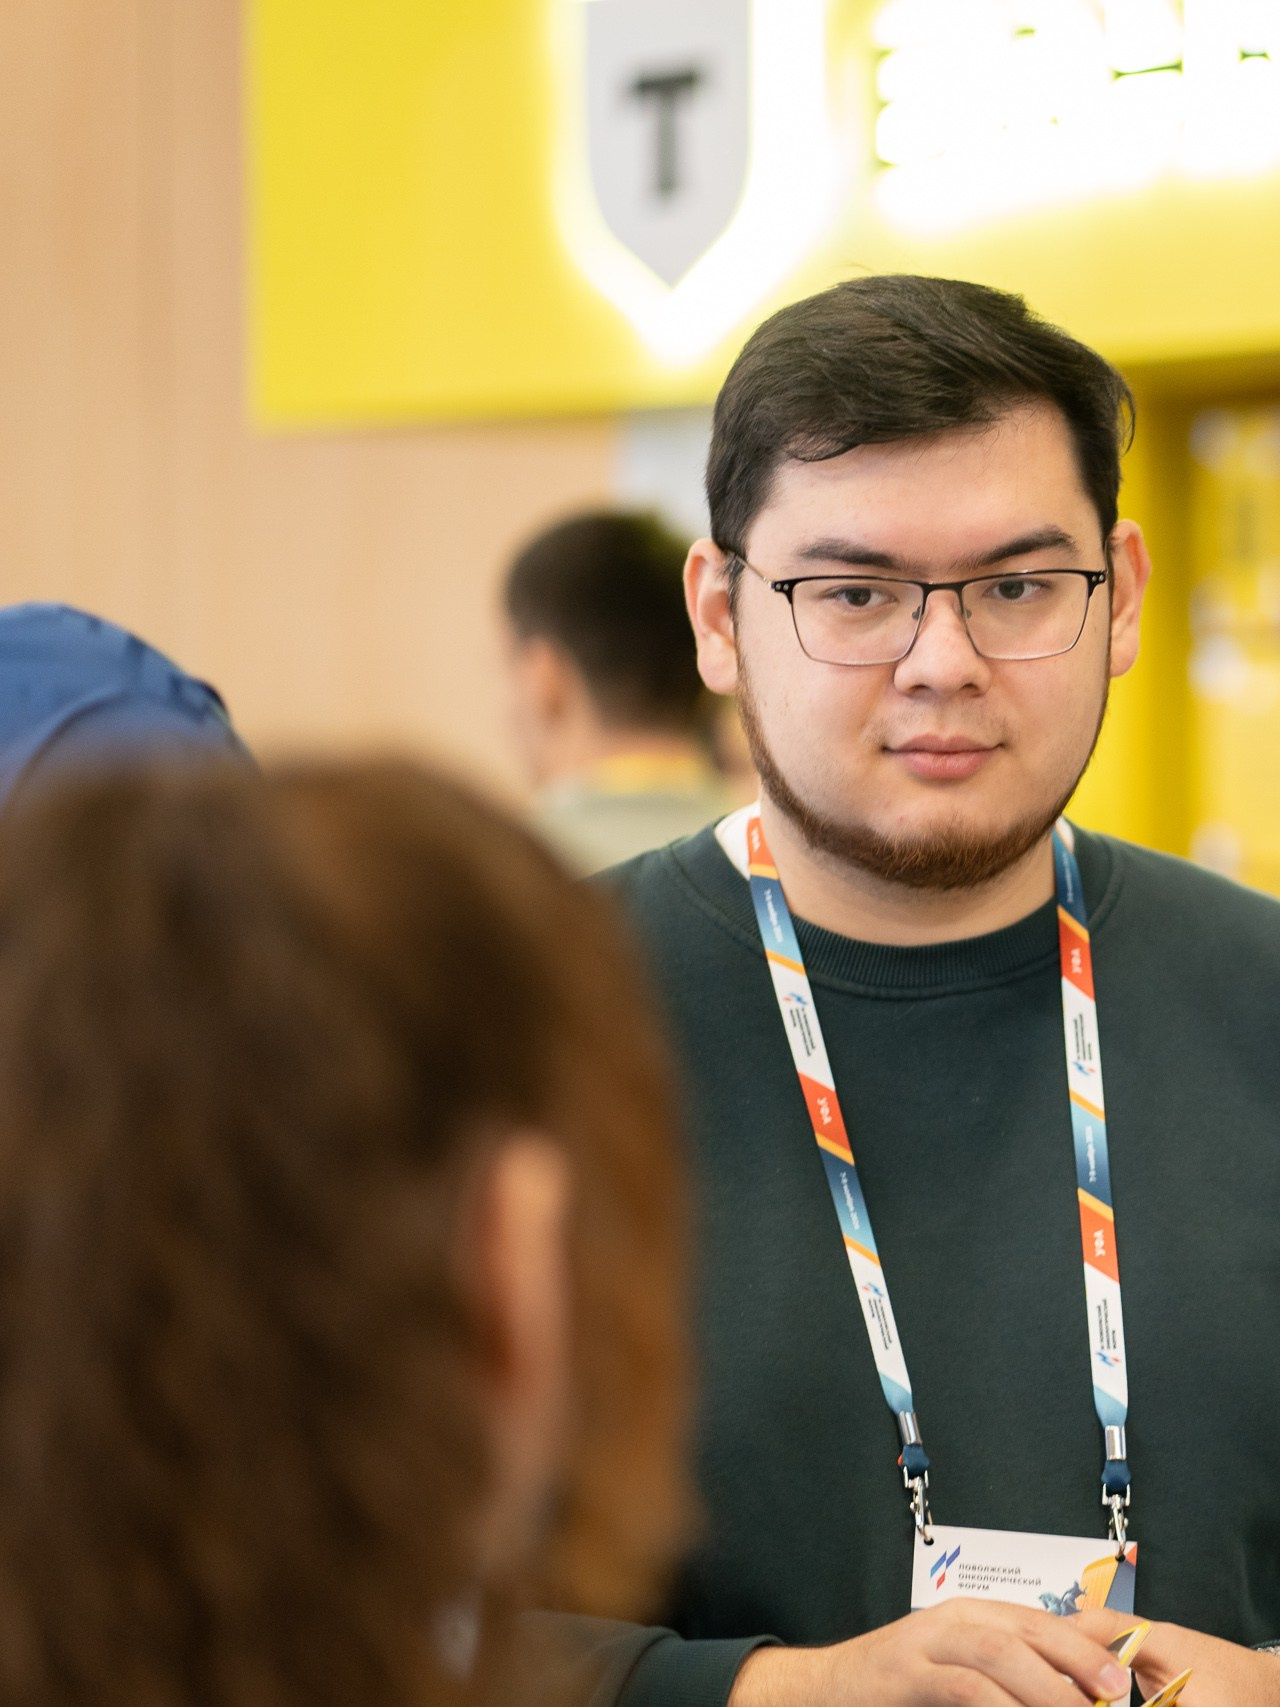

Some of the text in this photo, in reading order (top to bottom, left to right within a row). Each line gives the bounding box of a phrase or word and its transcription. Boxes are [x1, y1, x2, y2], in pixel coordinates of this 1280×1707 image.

[958, 1563, 1021, 1575] ПОВОЛЖСКИЙ
[958, 1572, 1042, 1587] ОНКОЛОГИЧЕСКИЙ
[957, 1582, 990, 1591] ФОРУМ
